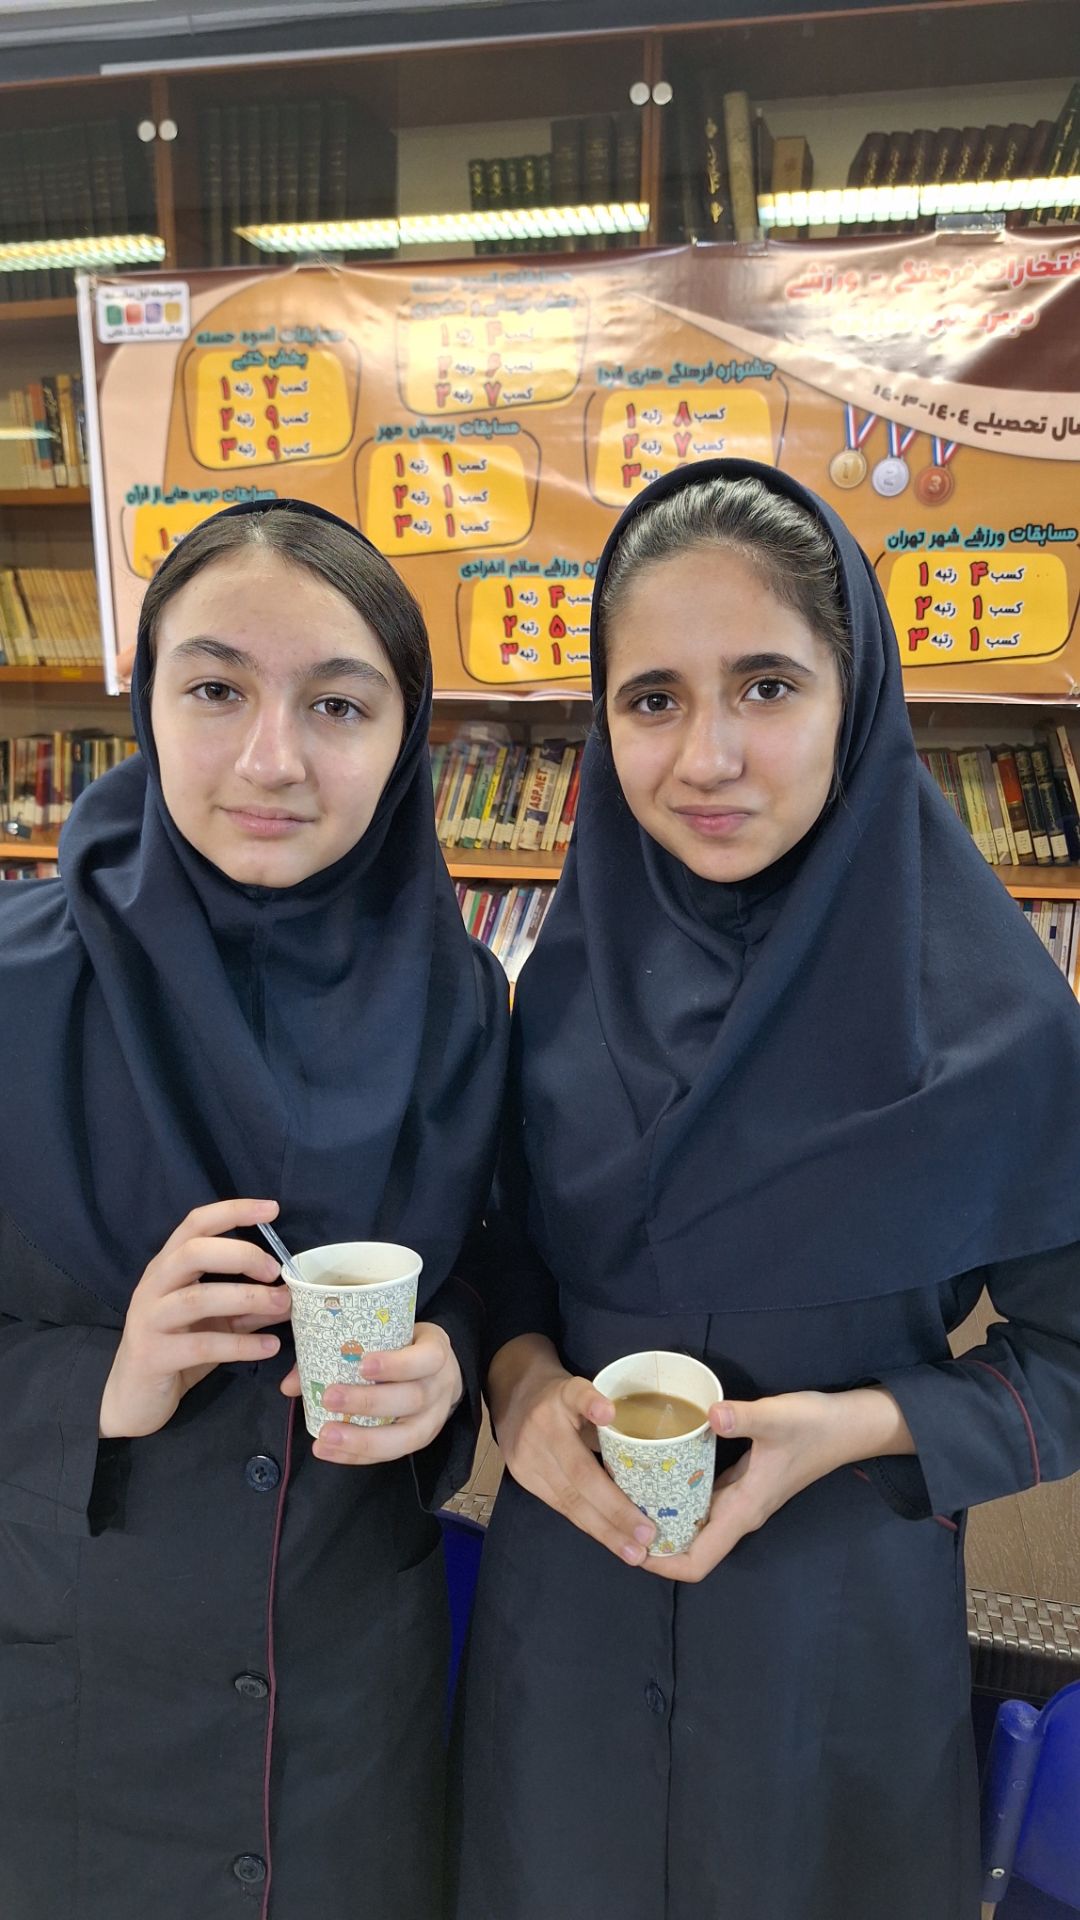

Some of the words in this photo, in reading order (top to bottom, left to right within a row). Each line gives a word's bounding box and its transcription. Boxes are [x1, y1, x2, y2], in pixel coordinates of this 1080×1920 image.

[785, 265, 859, 299] ورزشی
[667, 361, 714, 387] فرهنگی
[716, 357, 776, 382] جشنواره
[220, 376, 230, 400] ۱
[235, 382, 253, 397] رتبه
[262, 374, 279, 400] ۷
[281, 381, 308, 395] کسب
[452, 389, 473, 404] رتبه
[484, 382, 501, 408] ۷
[503, 388, 533, 402] کسب
[220, 407, 234, 431] ۲
[236, 412, 255, 427] رتبه
[265, 404, 279, 430] ۹
[282, 412, 309, 426] کسب
[626, 403, 636, 429] ۱
[642, 409, 662, 424] رتبه
[674, 401, 691, 427] ۸
[695, 407, 725, 421] کسب
[973, 412, 1047, 435] تحصیلی
[460, 417, 522, 440] مسابقات
[220, 437, 237, 461] ۳
[238, 443, 256, 457] رتبه
[266, 435, 280, 461] ۹
[283, 442, 310, 456] کسب
[641, 440, 662, 455] رتبه
[674, 432, 692, 458] ۷
[693, 438, 724, 451] کسب
[394, 453, 405, 478] ۱
[409, 459, 429, 474] رتبه
[443, 452, 453, 477] ۱
[458, 459, 487, 471] کسب
[622, 463, 641, 488] ۳
[393, 485, 408, 509] ۲
[411, 491, 430, 506] رتبه
[443, 484, 453, 508] ۱
[459, 490, 488, 503] کسب
[394, 513, 412, 538] ۳
[413, 520, 432, 535] رتبه
[445, 513, 455, 537] ۱
[460, 520, 489, 534] کسب
[1009, 523, 1079, 547] مسابقات
[887, 528, 926, 550] تهران
[928, 527, 960, 549] شهر
[963, 525, 1006, 549] ورزشی
[460, 560, 505, 580] انفرادی
[509, 559, 540, 578] سلام
[543, 558, 580, 577] ورزشی
[919, 562, 929, 587] ۱
[935, 568, 957, 583] رتبه
[970, 561, 988, 586] ۴
[990, 567, 1024, 582] کسب
[504, 585, 514, 608] ۱
[519, 592, 538, 605] رتبه
[549, 585, 565, 608] ۴
[567, 593, 592, 606] سب
[915, 596, 932, 620] ۲
[973, 595, 983, 620] ۱
[934, 602, 956, 616] رتبه
[989, 602, 1023, 617] کسب
[503, 615, 517, 638] ۲
[520, 622, 539, 635] رتبه
[549, 615, 566, 638] ۵
[567, 625, 589, 637] سب
[908, 627, 929, 651] ۳
[931, 634, 953, 649] رتبه
[970, 627, 980, 651] ۱
[986, 634, 1020, 649] کسب
[500, 642, 518, 665] ۳
[519, 649, 538, 662] رتبه
[552, 642, 561, 665] ۱
[566, 653, 589, 664] سب
[529, 767, 549, 809] ASP.NET
